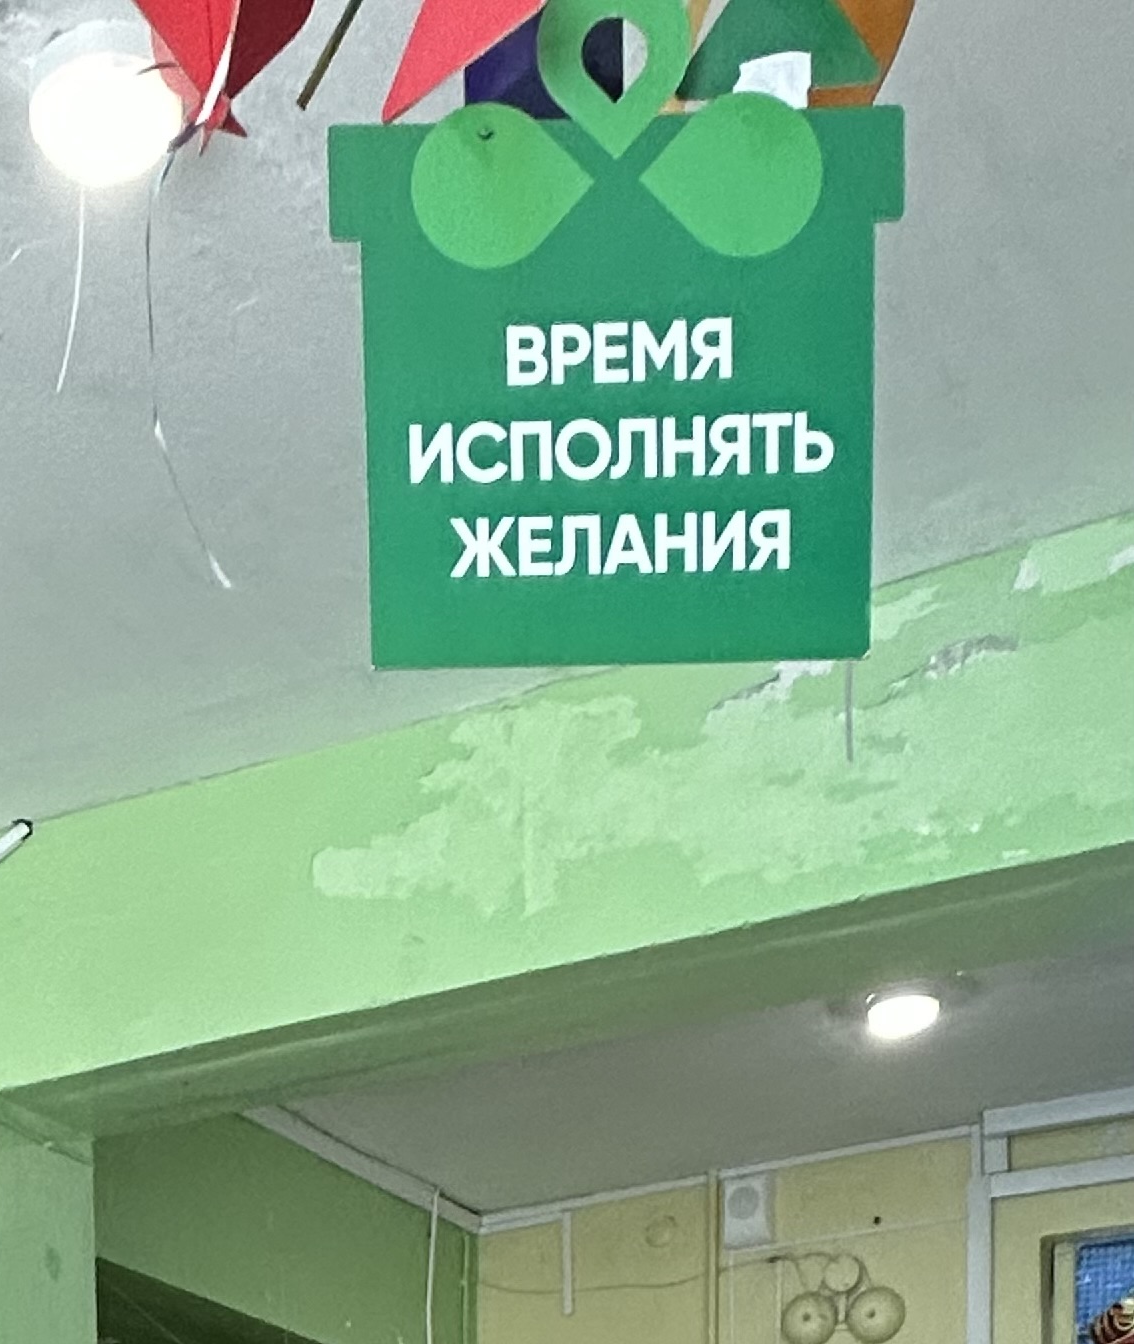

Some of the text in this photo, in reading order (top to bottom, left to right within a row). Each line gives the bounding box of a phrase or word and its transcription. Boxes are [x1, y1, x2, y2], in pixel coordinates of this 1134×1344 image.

[506, 316, 733, 387] ВРЕМЯ
[408, 411, 835, 484] ИСПОЛНЯТЬ
[450, 509, 791, 579] ЖЕЛАНИЯ
